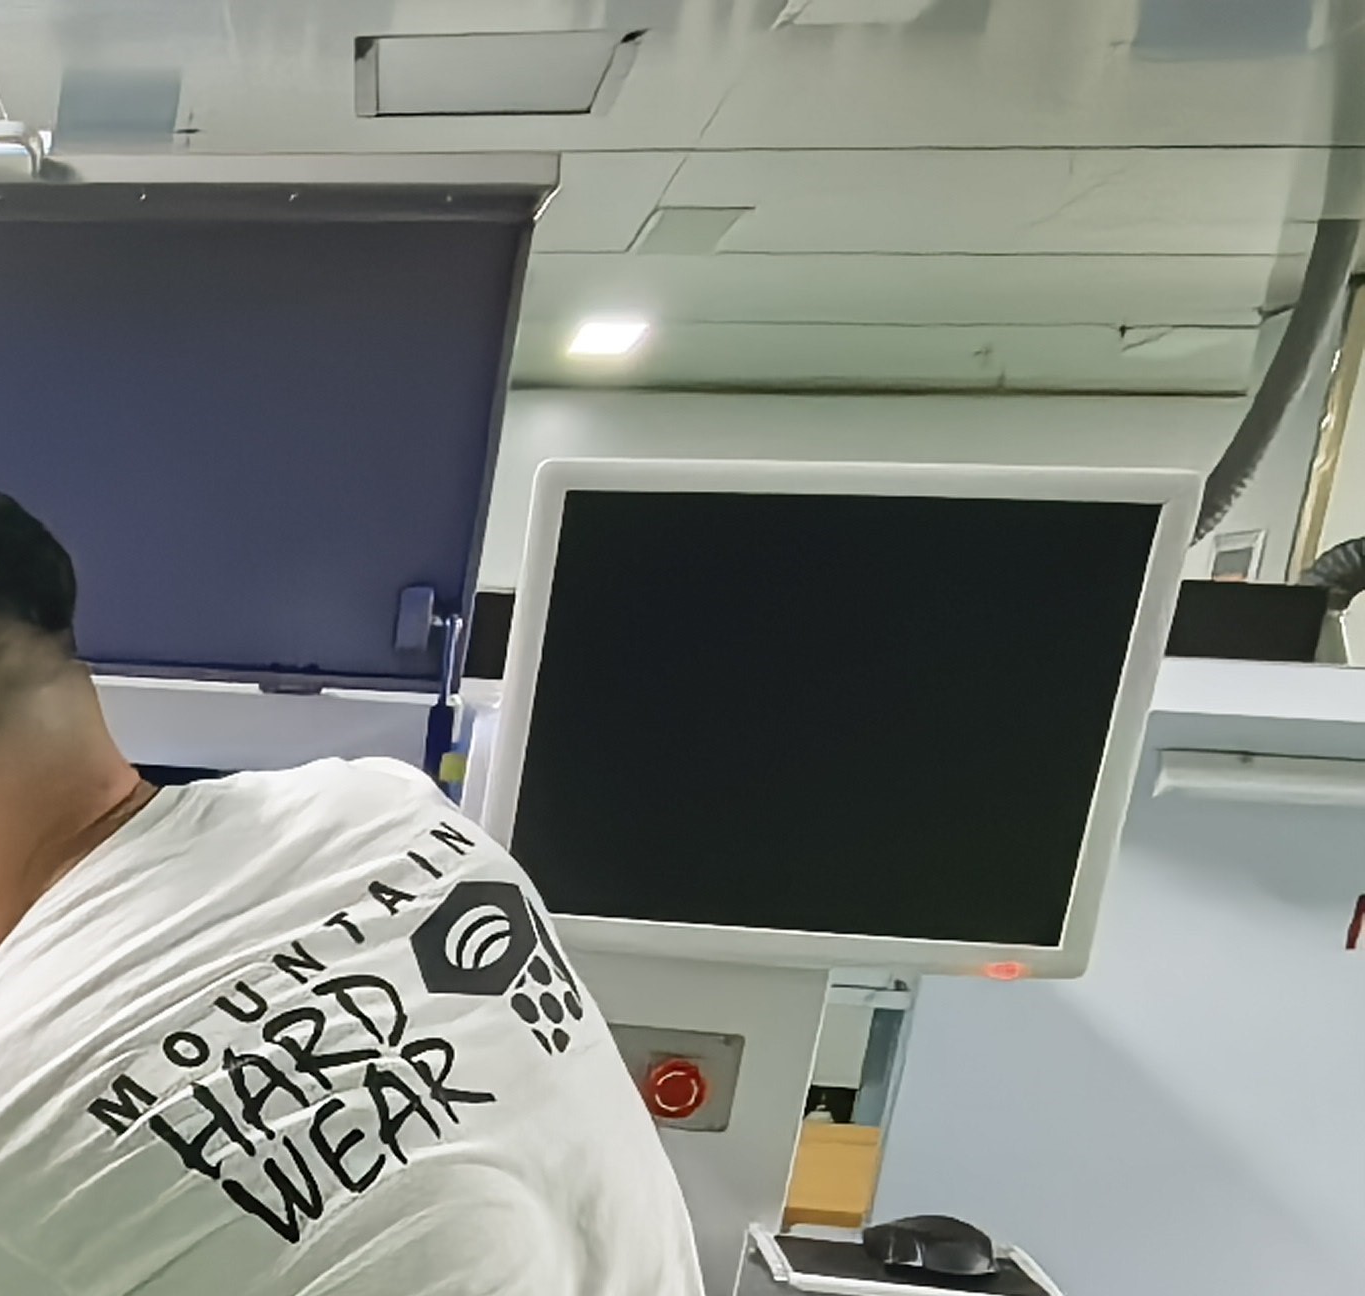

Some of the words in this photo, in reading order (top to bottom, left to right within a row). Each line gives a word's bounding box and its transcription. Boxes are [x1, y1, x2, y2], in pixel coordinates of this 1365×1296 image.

[86, 821, 475, 1136] MOUNTAIN
[149, 974, 408, 1180] HARD
[222, 1036, 497, 1244] WEAR
